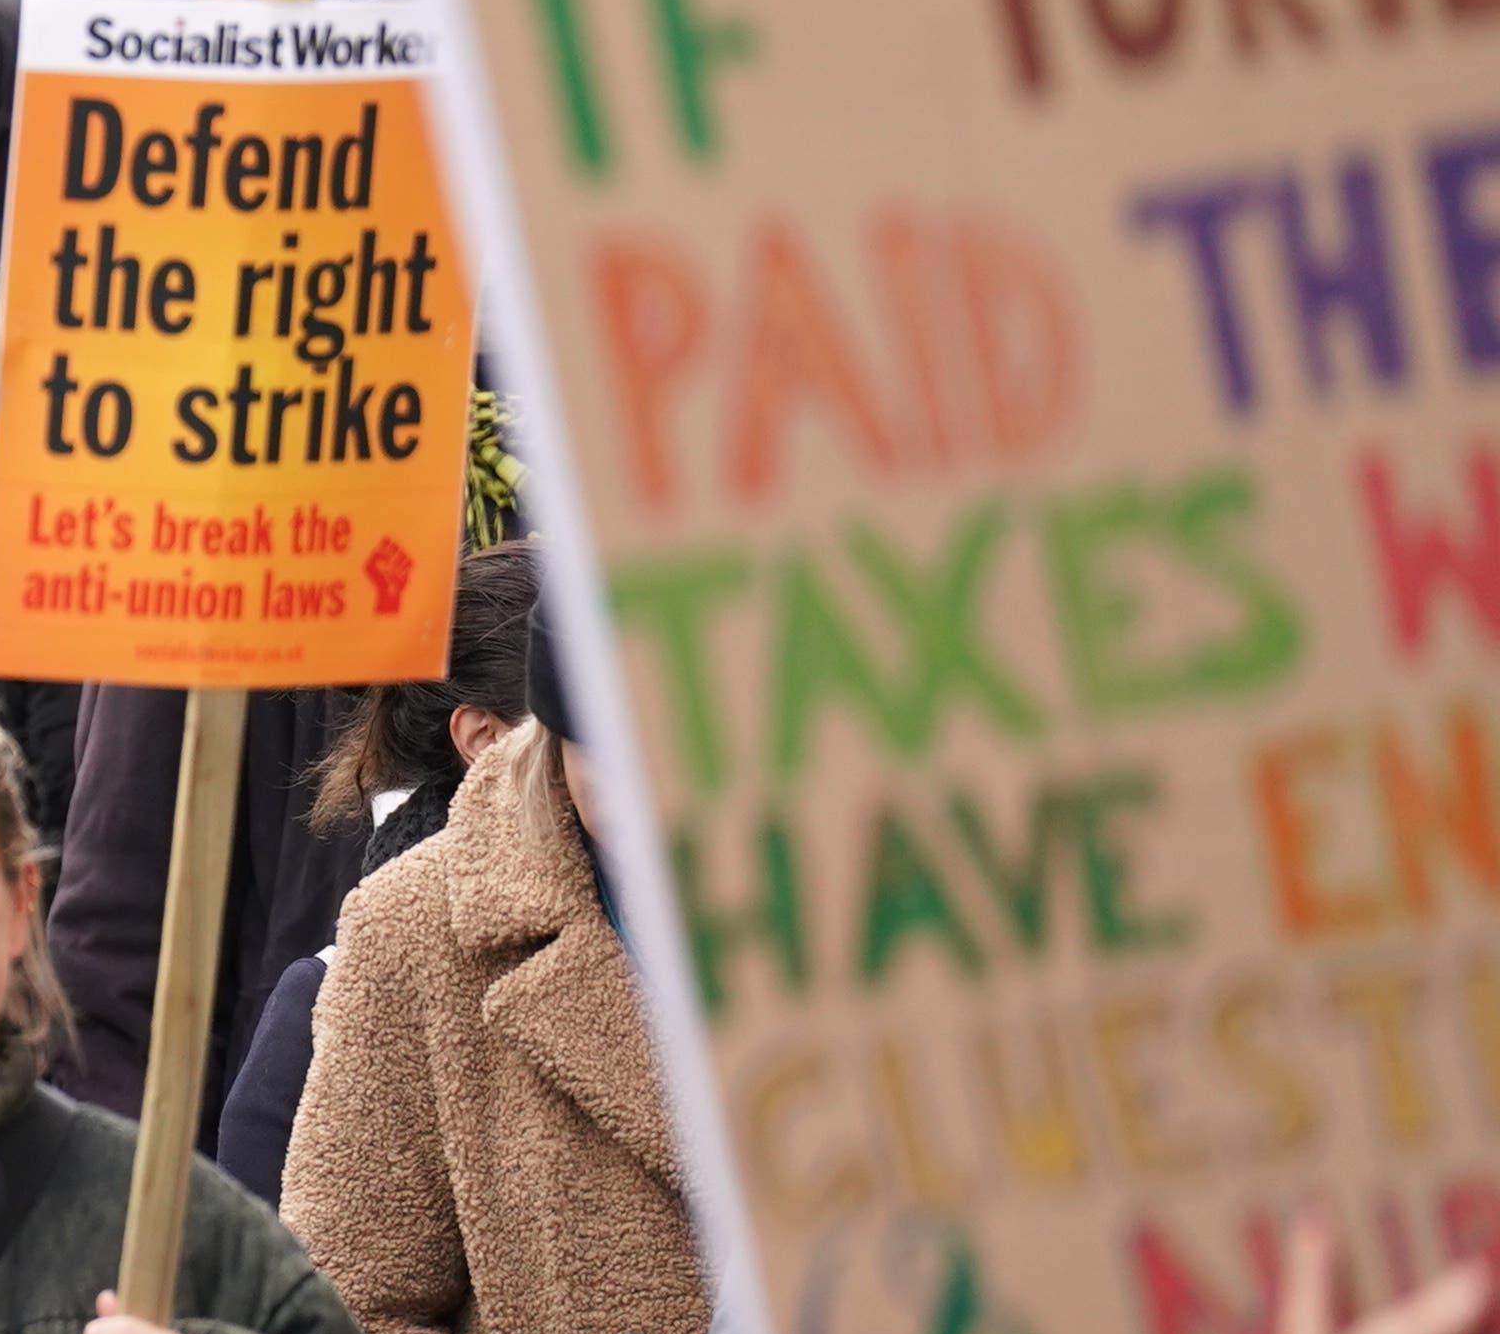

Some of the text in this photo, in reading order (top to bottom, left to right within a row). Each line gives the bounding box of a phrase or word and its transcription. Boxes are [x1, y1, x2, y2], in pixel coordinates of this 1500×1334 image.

[86, 15, 284, 69] Socialist
[62, 96, 378, 214] Defend
[52, 223, 437, 367] the right
[41, 350, 422, 465] to strike
[586, 212, 1082, 517] PAID
[27, 493, 353, 557] Let's break the
[21, 568, 347, 621] anti-union laws
[612, 462, 1310, 802] TAXES
[674, 763, 1196, 1025] HAVE
